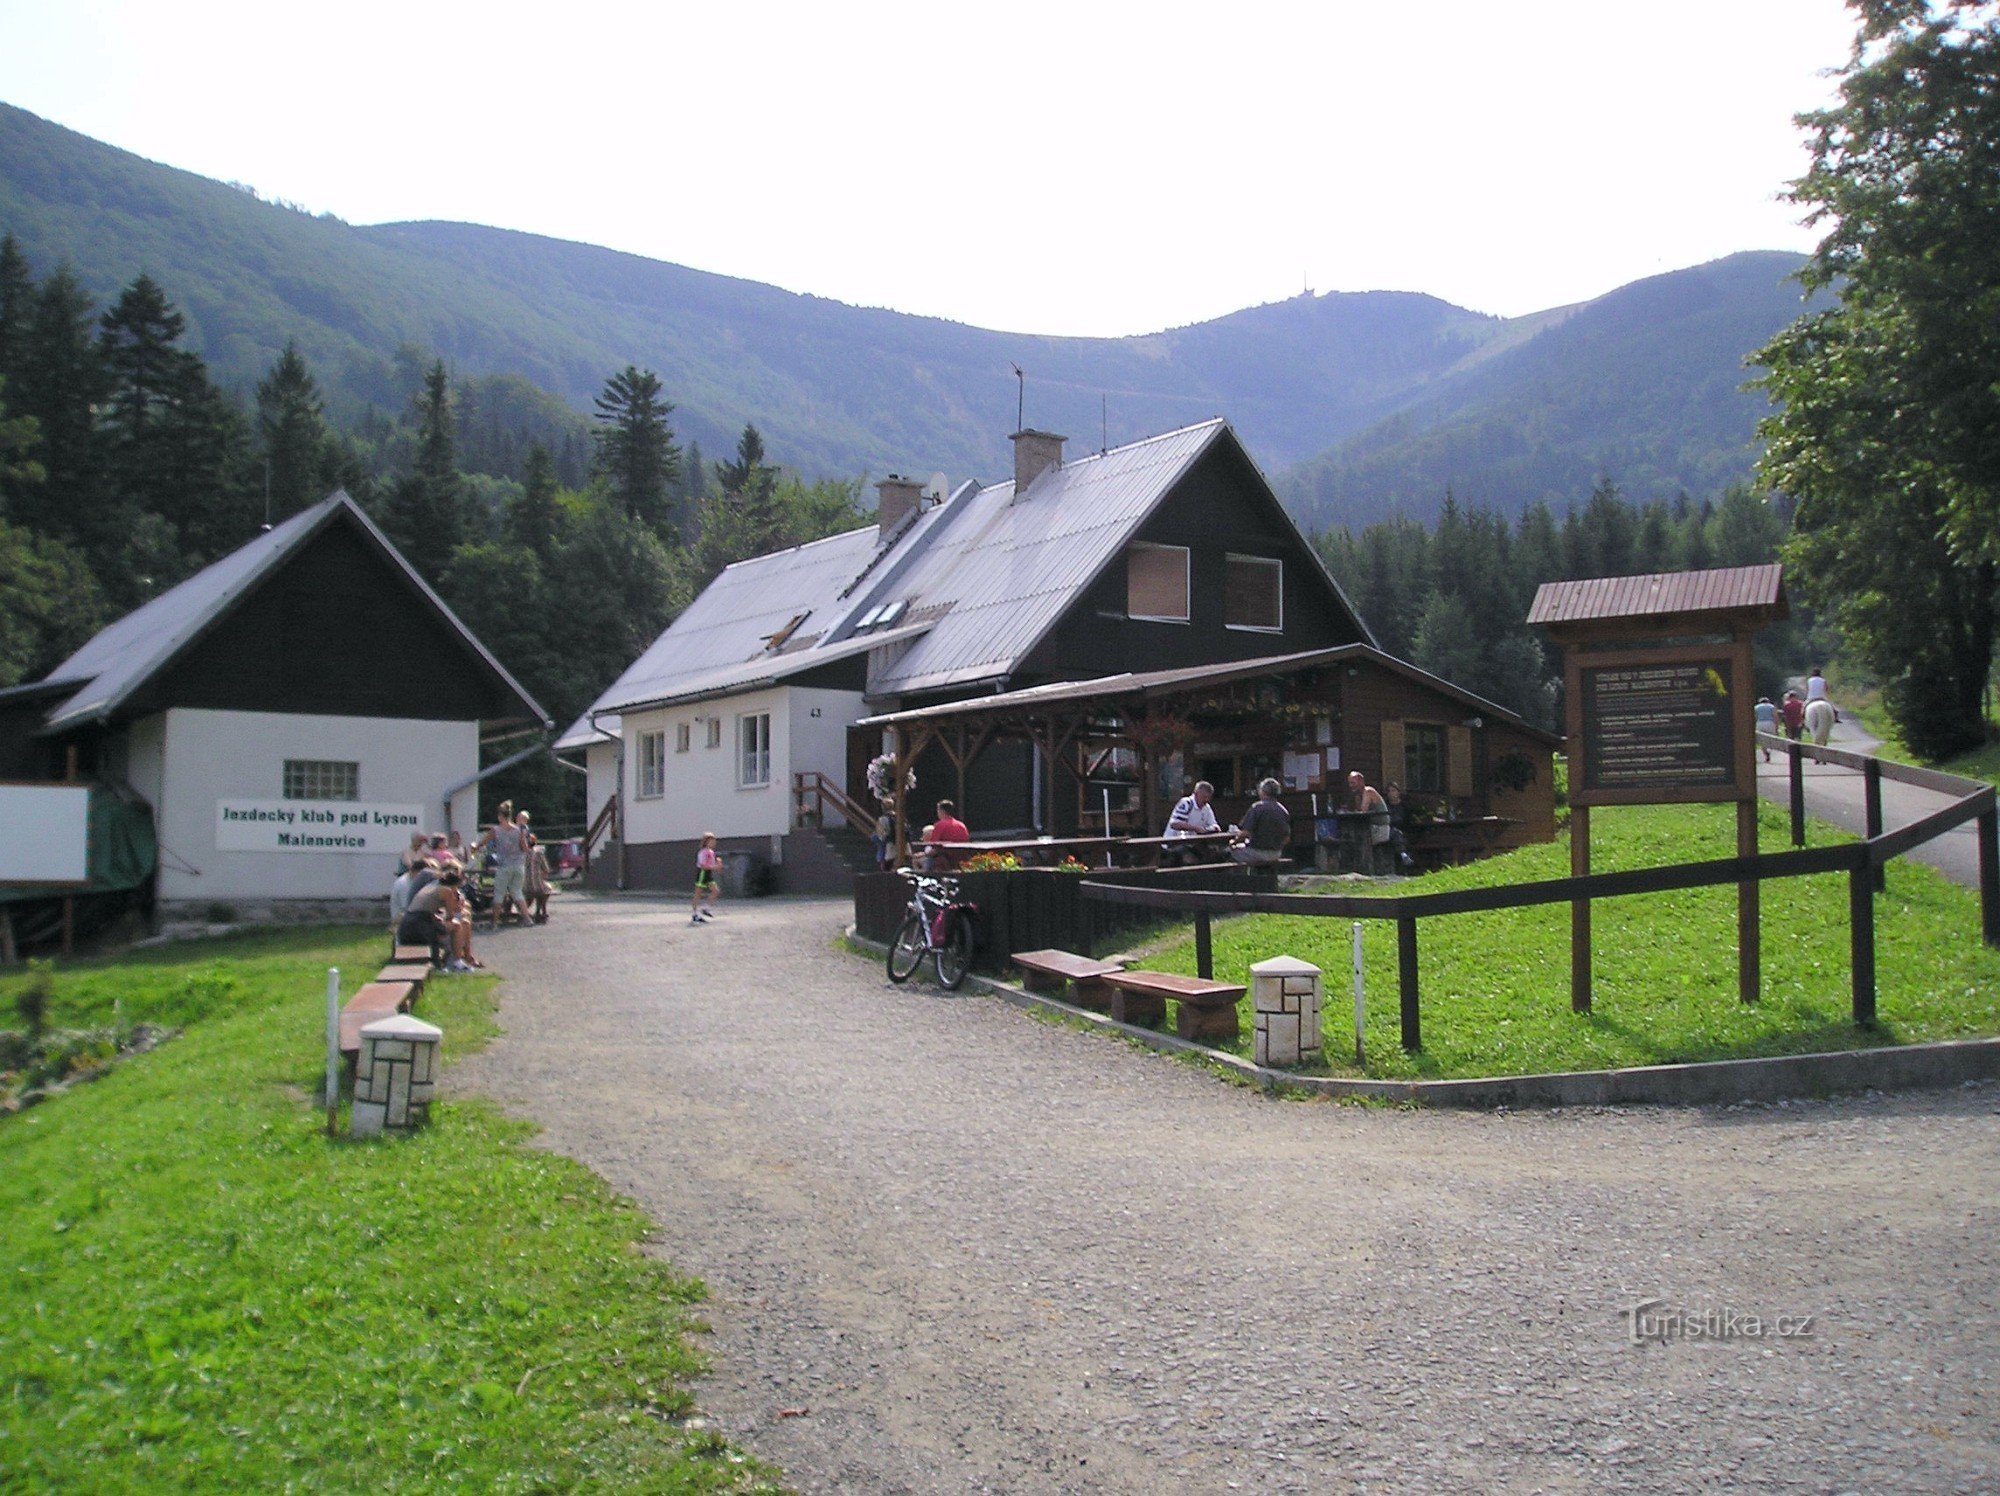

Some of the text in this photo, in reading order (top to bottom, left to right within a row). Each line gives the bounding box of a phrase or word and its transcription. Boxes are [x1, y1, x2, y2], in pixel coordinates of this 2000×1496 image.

[301, 809, 335, 823] klub
[341, 811, 368, 827] pod
[374, 812, 418, 828] Lysou
[277, 832, 366, 847] Malenovice
